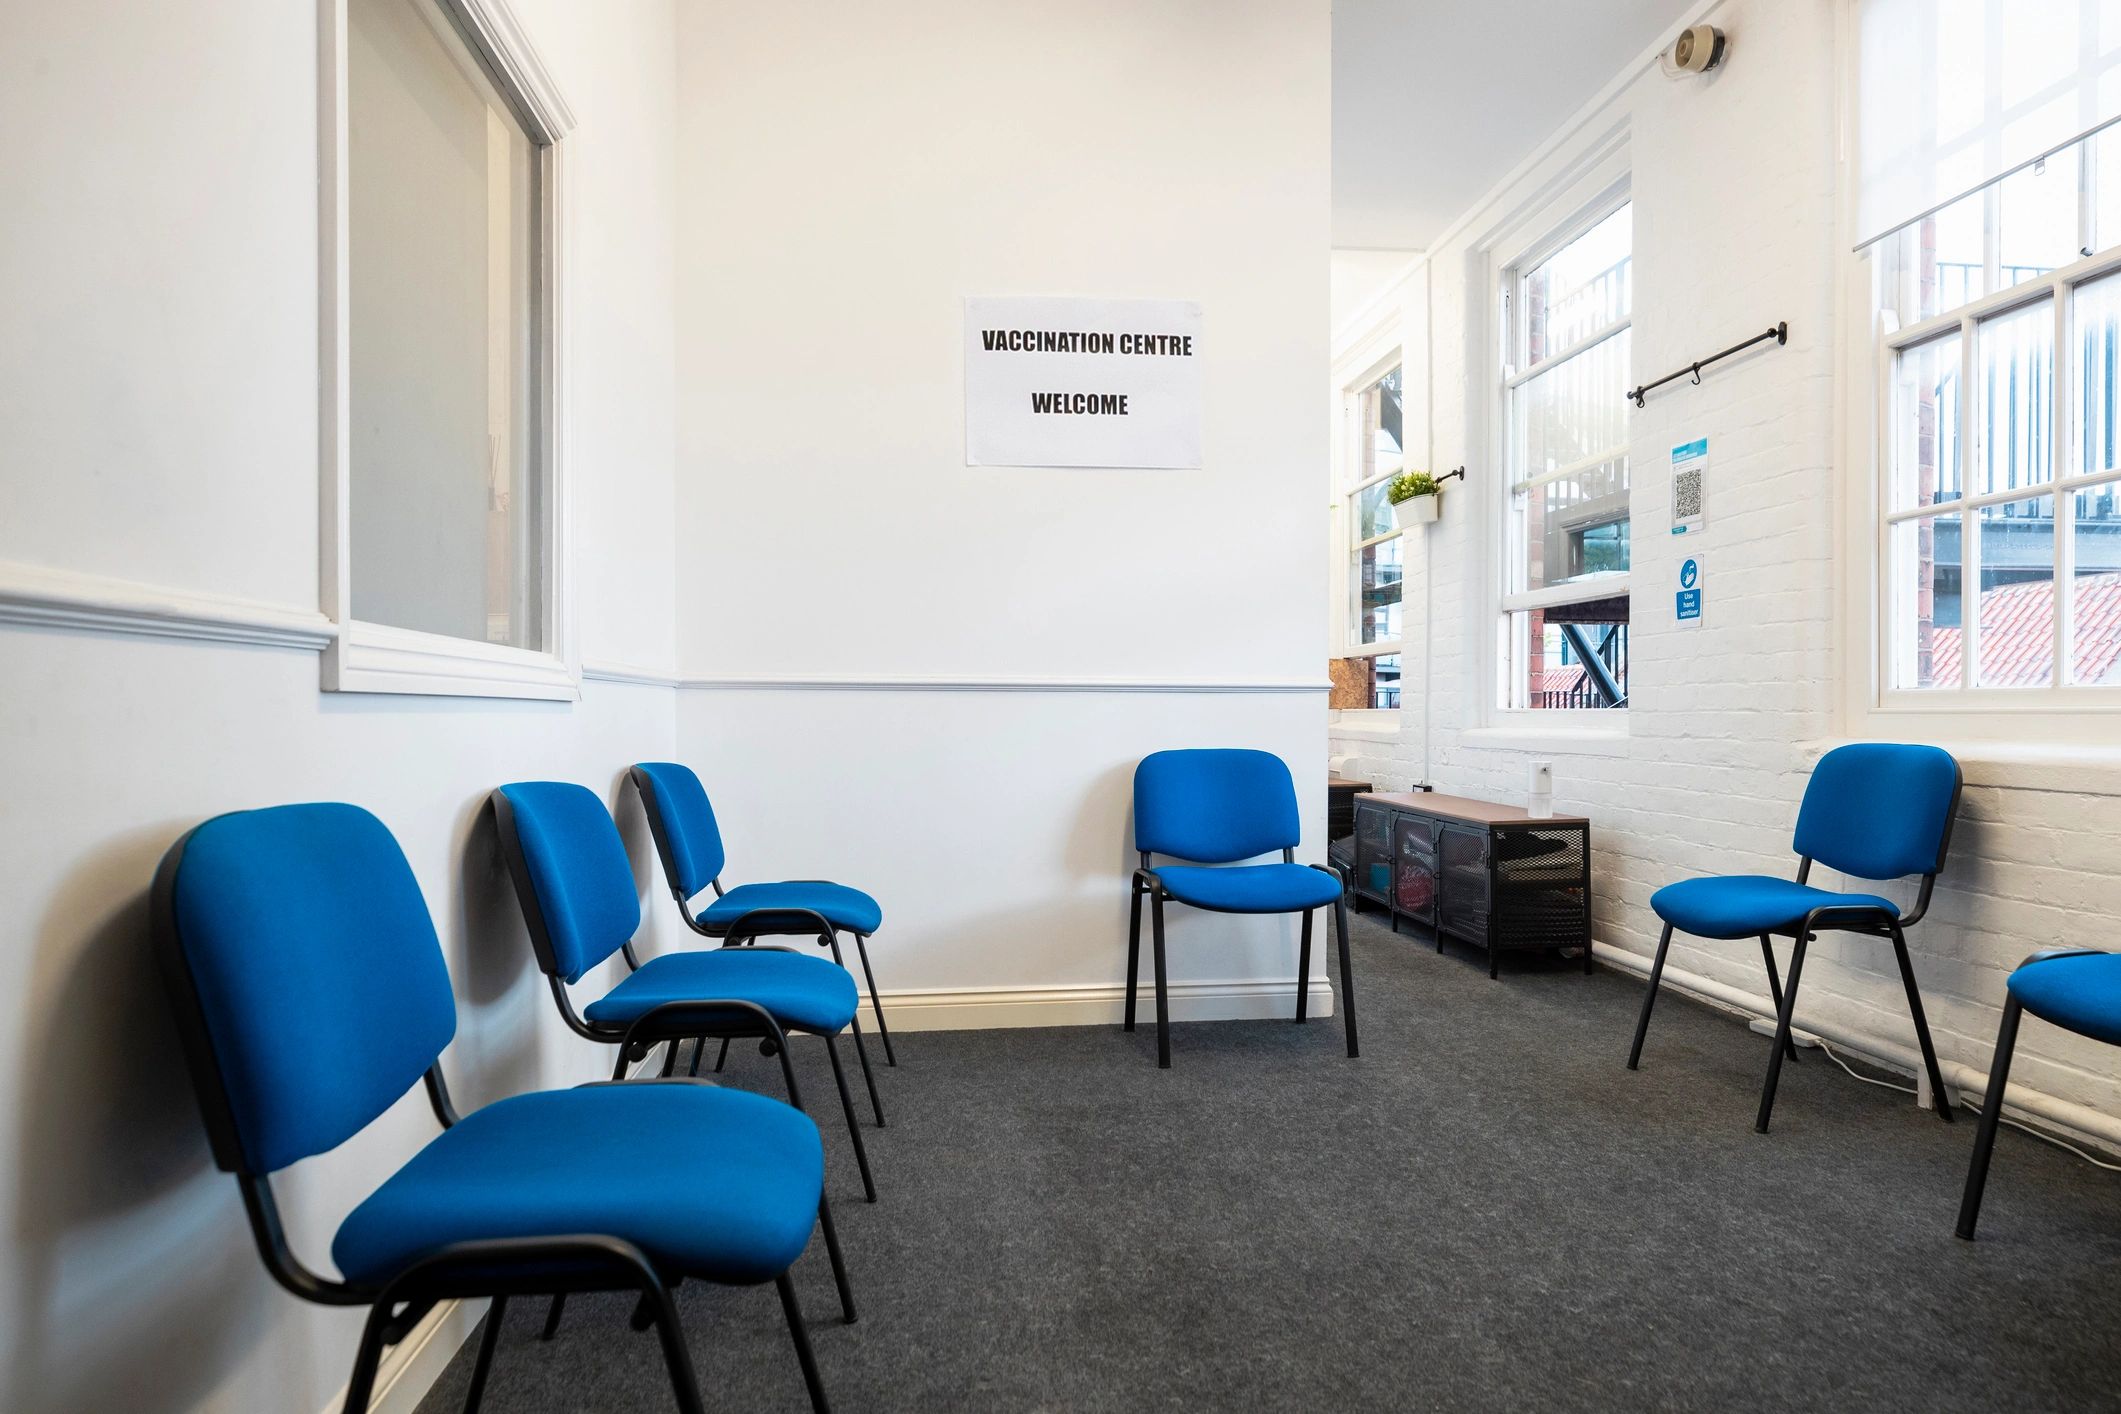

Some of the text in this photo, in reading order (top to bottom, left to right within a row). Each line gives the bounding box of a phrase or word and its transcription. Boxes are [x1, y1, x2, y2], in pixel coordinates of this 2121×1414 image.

[981, 330, 1192, 356] VACCINATION CENTRE
[1031, 392, 1129, 415] WELCOME
